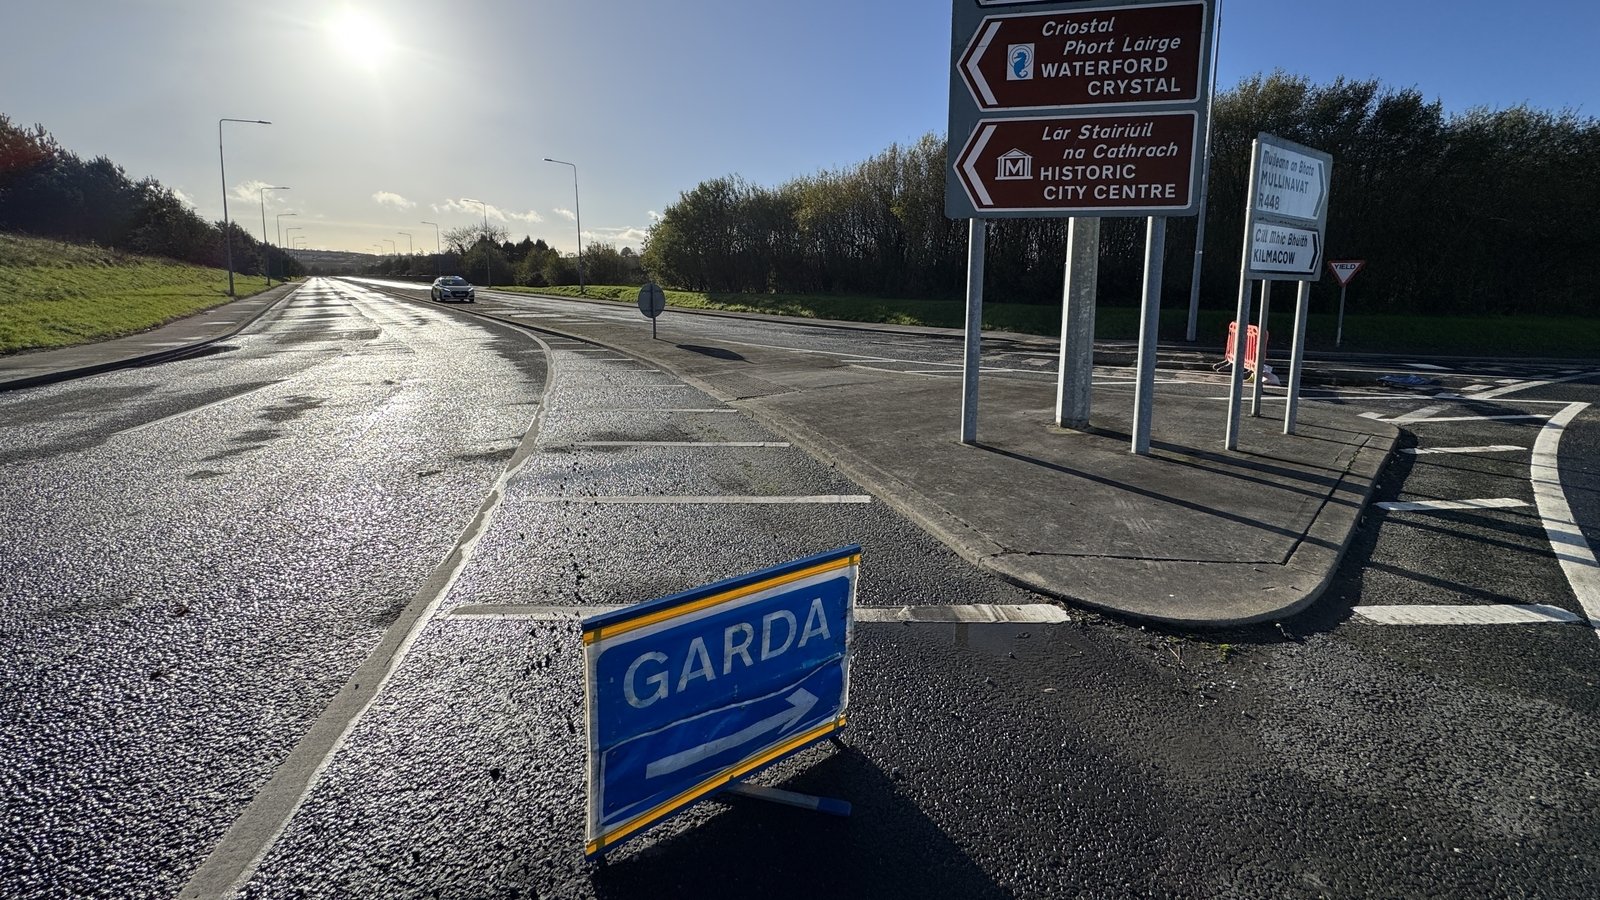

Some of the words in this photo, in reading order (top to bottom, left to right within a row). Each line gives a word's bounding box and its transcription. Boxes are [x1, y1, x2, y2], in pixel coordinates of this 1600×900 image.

[1041, 17, 1115, 37] Criostal
[1063, 40, 1114, 56] Phort
[1122, 36, 1181, 54] Láirge
[1041, 57, 1168, 78] WATERFORD
[1087, 77, 1181, 96] CRYSTAL
[1042, 126, 1071, 141] Lár
[1077, 122, 1153, 140] Stairiúil
[1063, 148, 1084, 160] na
[1093, 142, 1178, 159] Cathrach
[1040, 164, 1136, 181] HISTORIC
[1261, 170, 1309, 194] MULLINAVAT
[1043, 185, 1087, 201] CITY
[1093, 183, 1176, 200] CENTRE
[1259, 193, 1280, 210] R448
[1255, 228, 1268, 243] Cill
[1253, 248, 1296, 265] KILMACOW
[623, 597, 832, 709] GARDA
